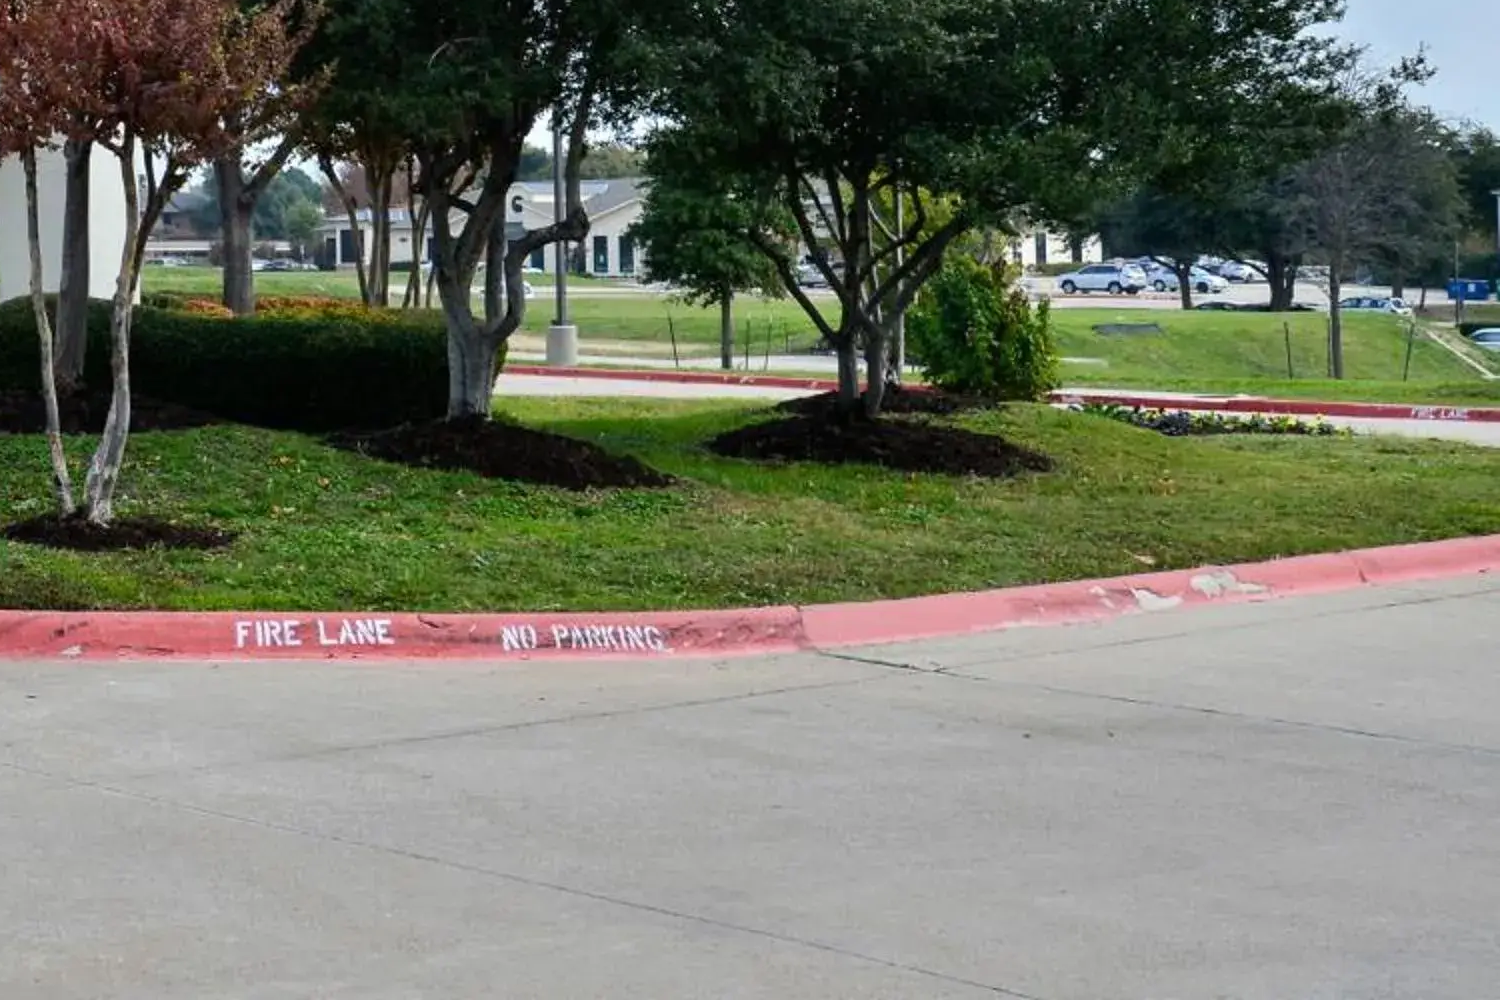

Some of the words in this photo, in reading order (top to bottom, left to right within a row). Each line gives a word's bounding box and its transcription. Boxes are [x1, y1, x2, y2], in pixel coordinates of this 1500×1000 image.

[236, 620, 302, 648] FIRE
[317, 618, 394, 645] LANE
[502, 624, 537, 651] NO
[552, 623, 665, 652] PARKING
